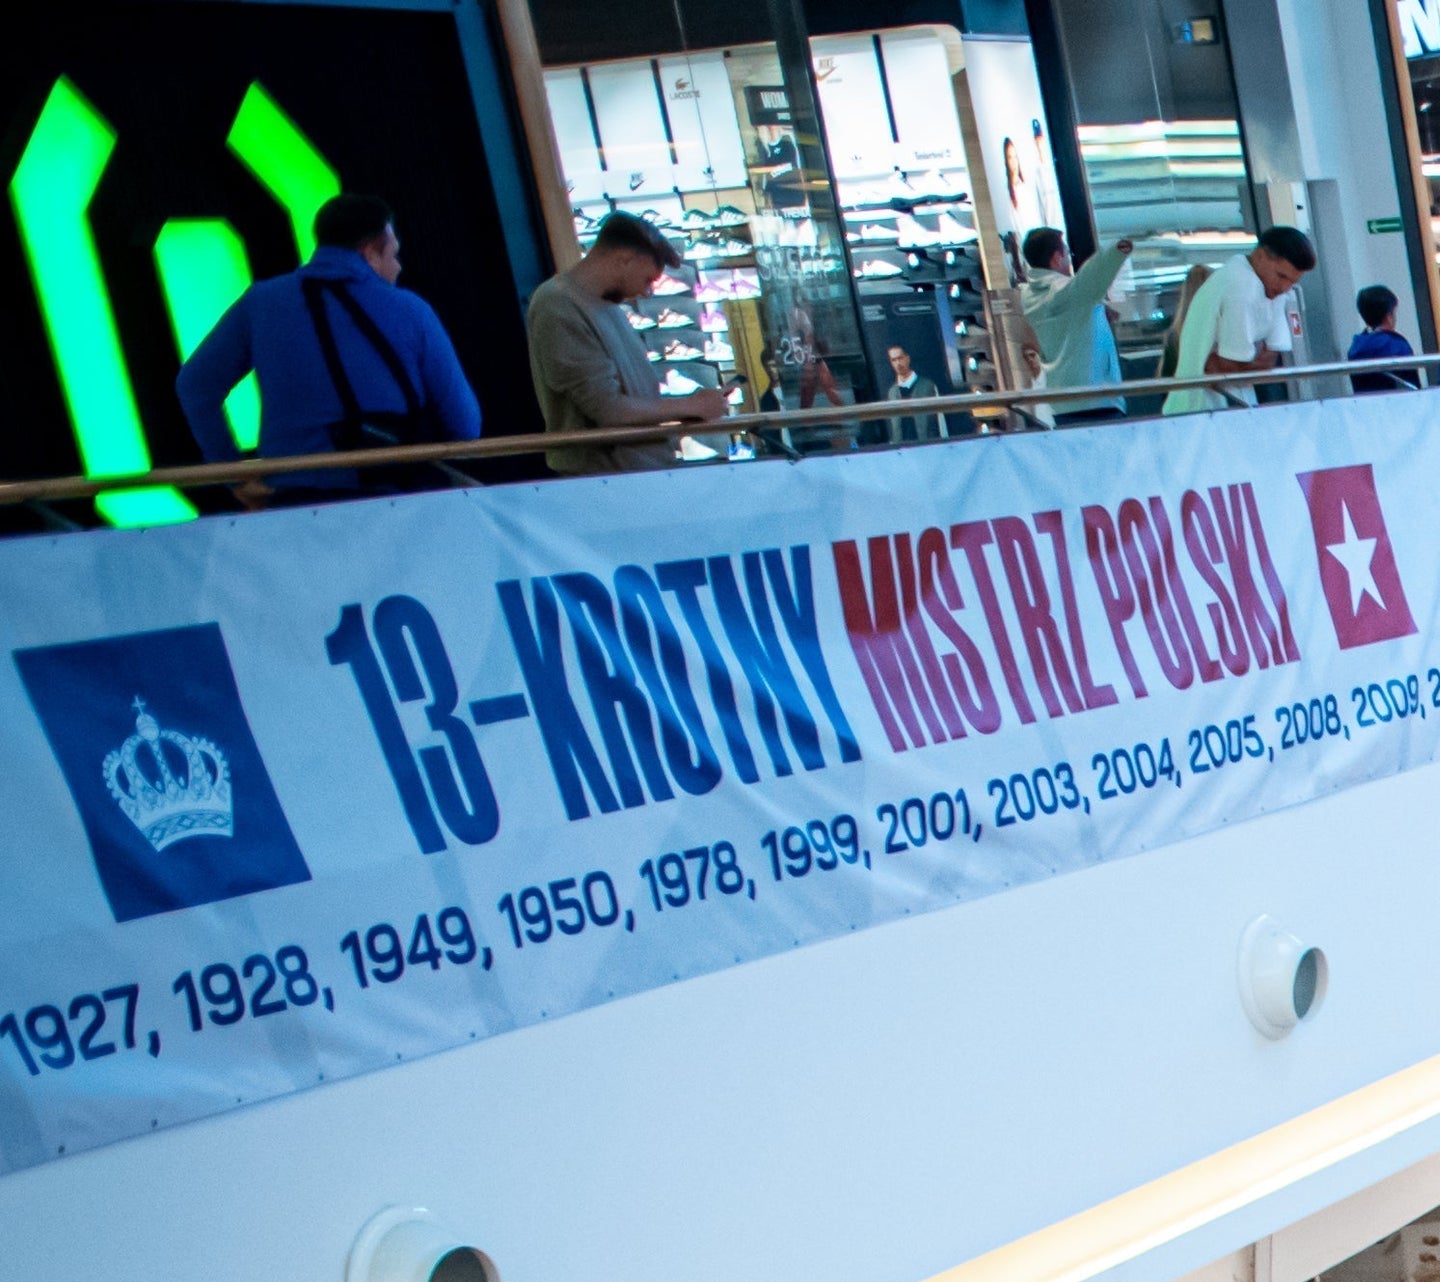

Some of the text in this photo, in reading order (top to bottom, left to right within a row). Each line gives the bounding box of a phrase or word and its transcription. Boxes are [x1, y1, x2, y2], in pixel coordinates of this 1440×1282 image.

[324, 482, 1301, 855] 13-KROTNY MISTRZ POLSKI
[0, 983, 161, 1078] 1927,
[172, 944, 335, 1034] 1928,
[340, 905, 495, 990] 1949,
[498, 870, 636, 949] 1950,
[639, 838, 757, 913] 1978,
[761, 822, 872, 883] 1999,
[877, 789, 985, 857] 2001,
[987, 762, 1091, 828] 2003,
[1091, 742, 1183, 802] 2004,
[1187, 718, 1276, 774] 2005,
[1275, 693, 1351, 751] 2008,
[1351, 674, 1427, 730] 2009,
